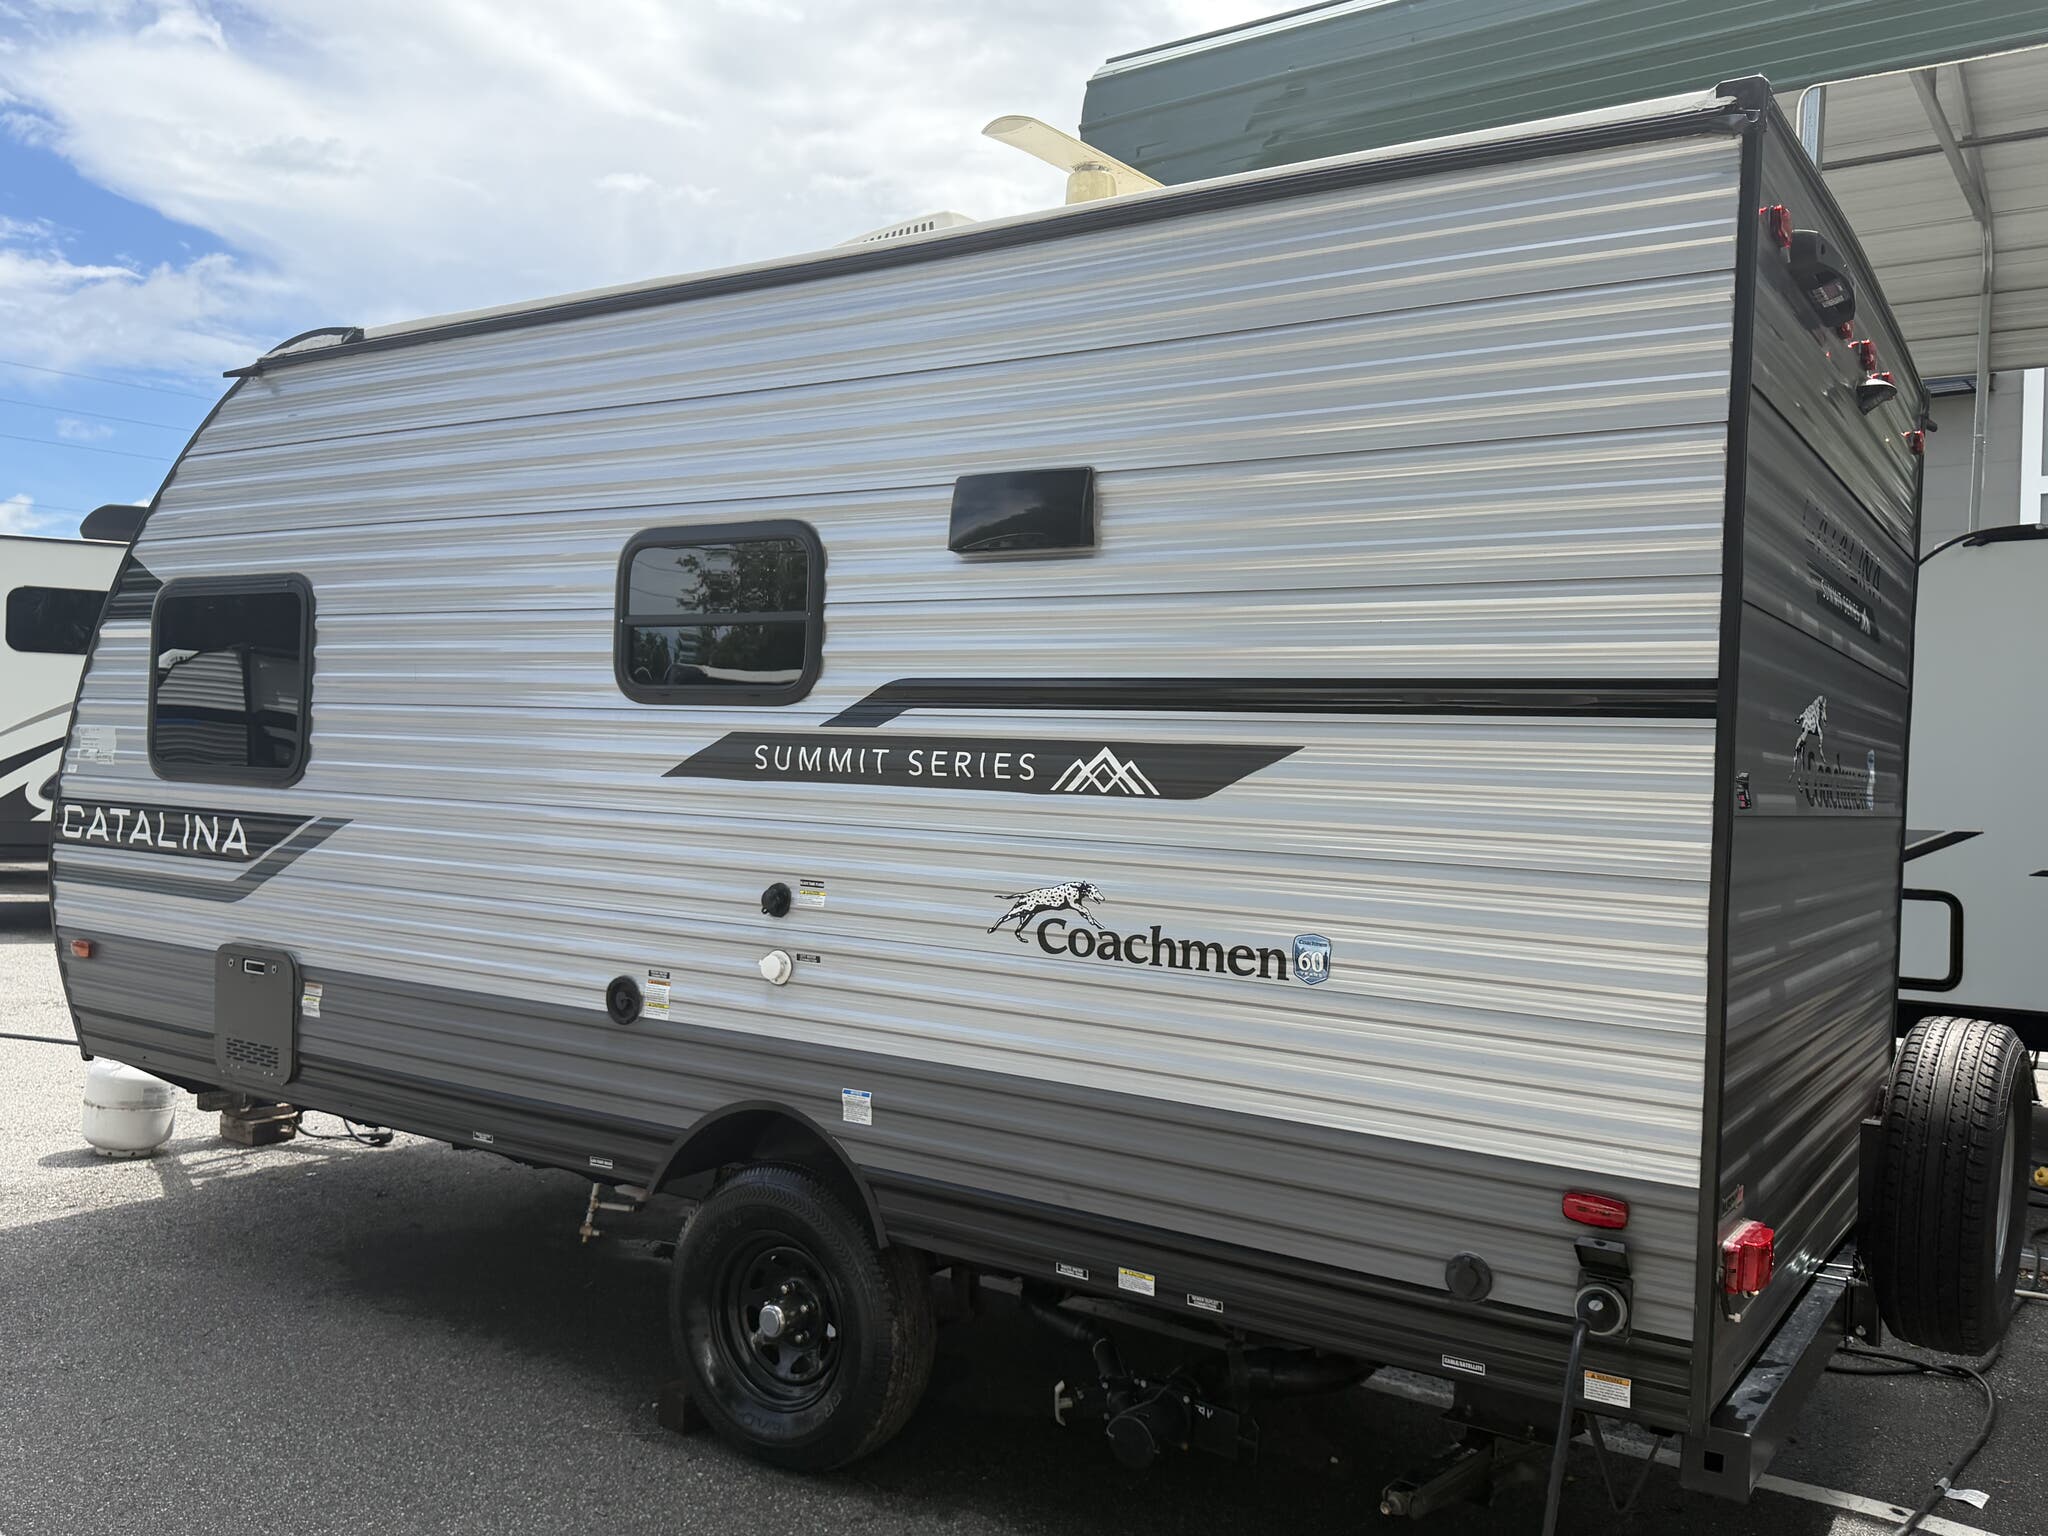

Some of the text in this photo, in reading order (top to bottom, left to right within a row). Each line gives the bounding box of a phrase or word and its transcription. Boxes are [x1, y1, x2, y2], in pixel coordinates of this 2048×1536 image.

[754, 744, 1037, 781] SUMMIT SERIES
[62, 804, 250, 856] CATALINA
[1036, 917, 1290, 981] Coachmen
[1297, 951, 1324, 972] 60
